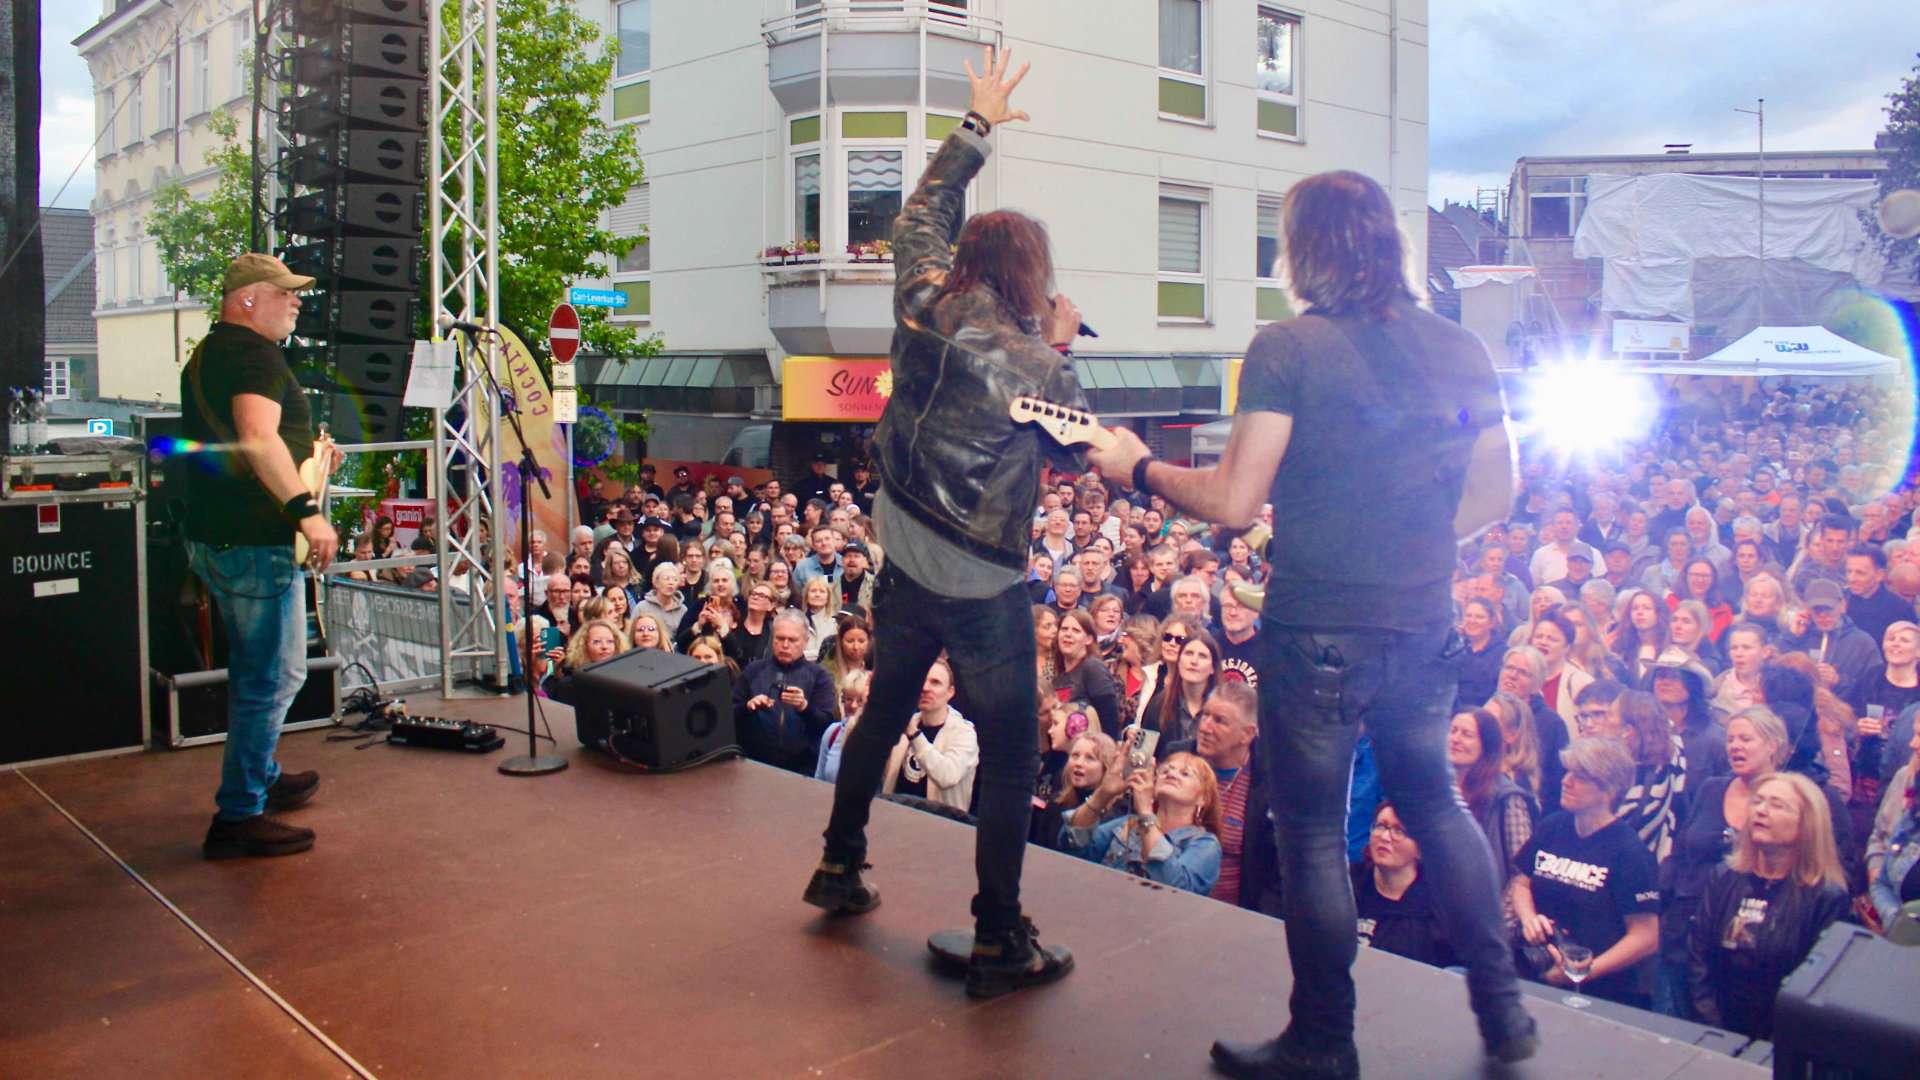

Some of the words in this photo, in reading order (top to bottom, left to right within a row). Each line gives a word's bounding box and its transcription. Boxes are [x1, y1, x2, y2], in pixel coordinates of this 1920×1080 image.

[838, 402, 883, 412] SONNEN
[395, 507, 423, 523] granini
[12, 551, 93, 575] BOUNCE
